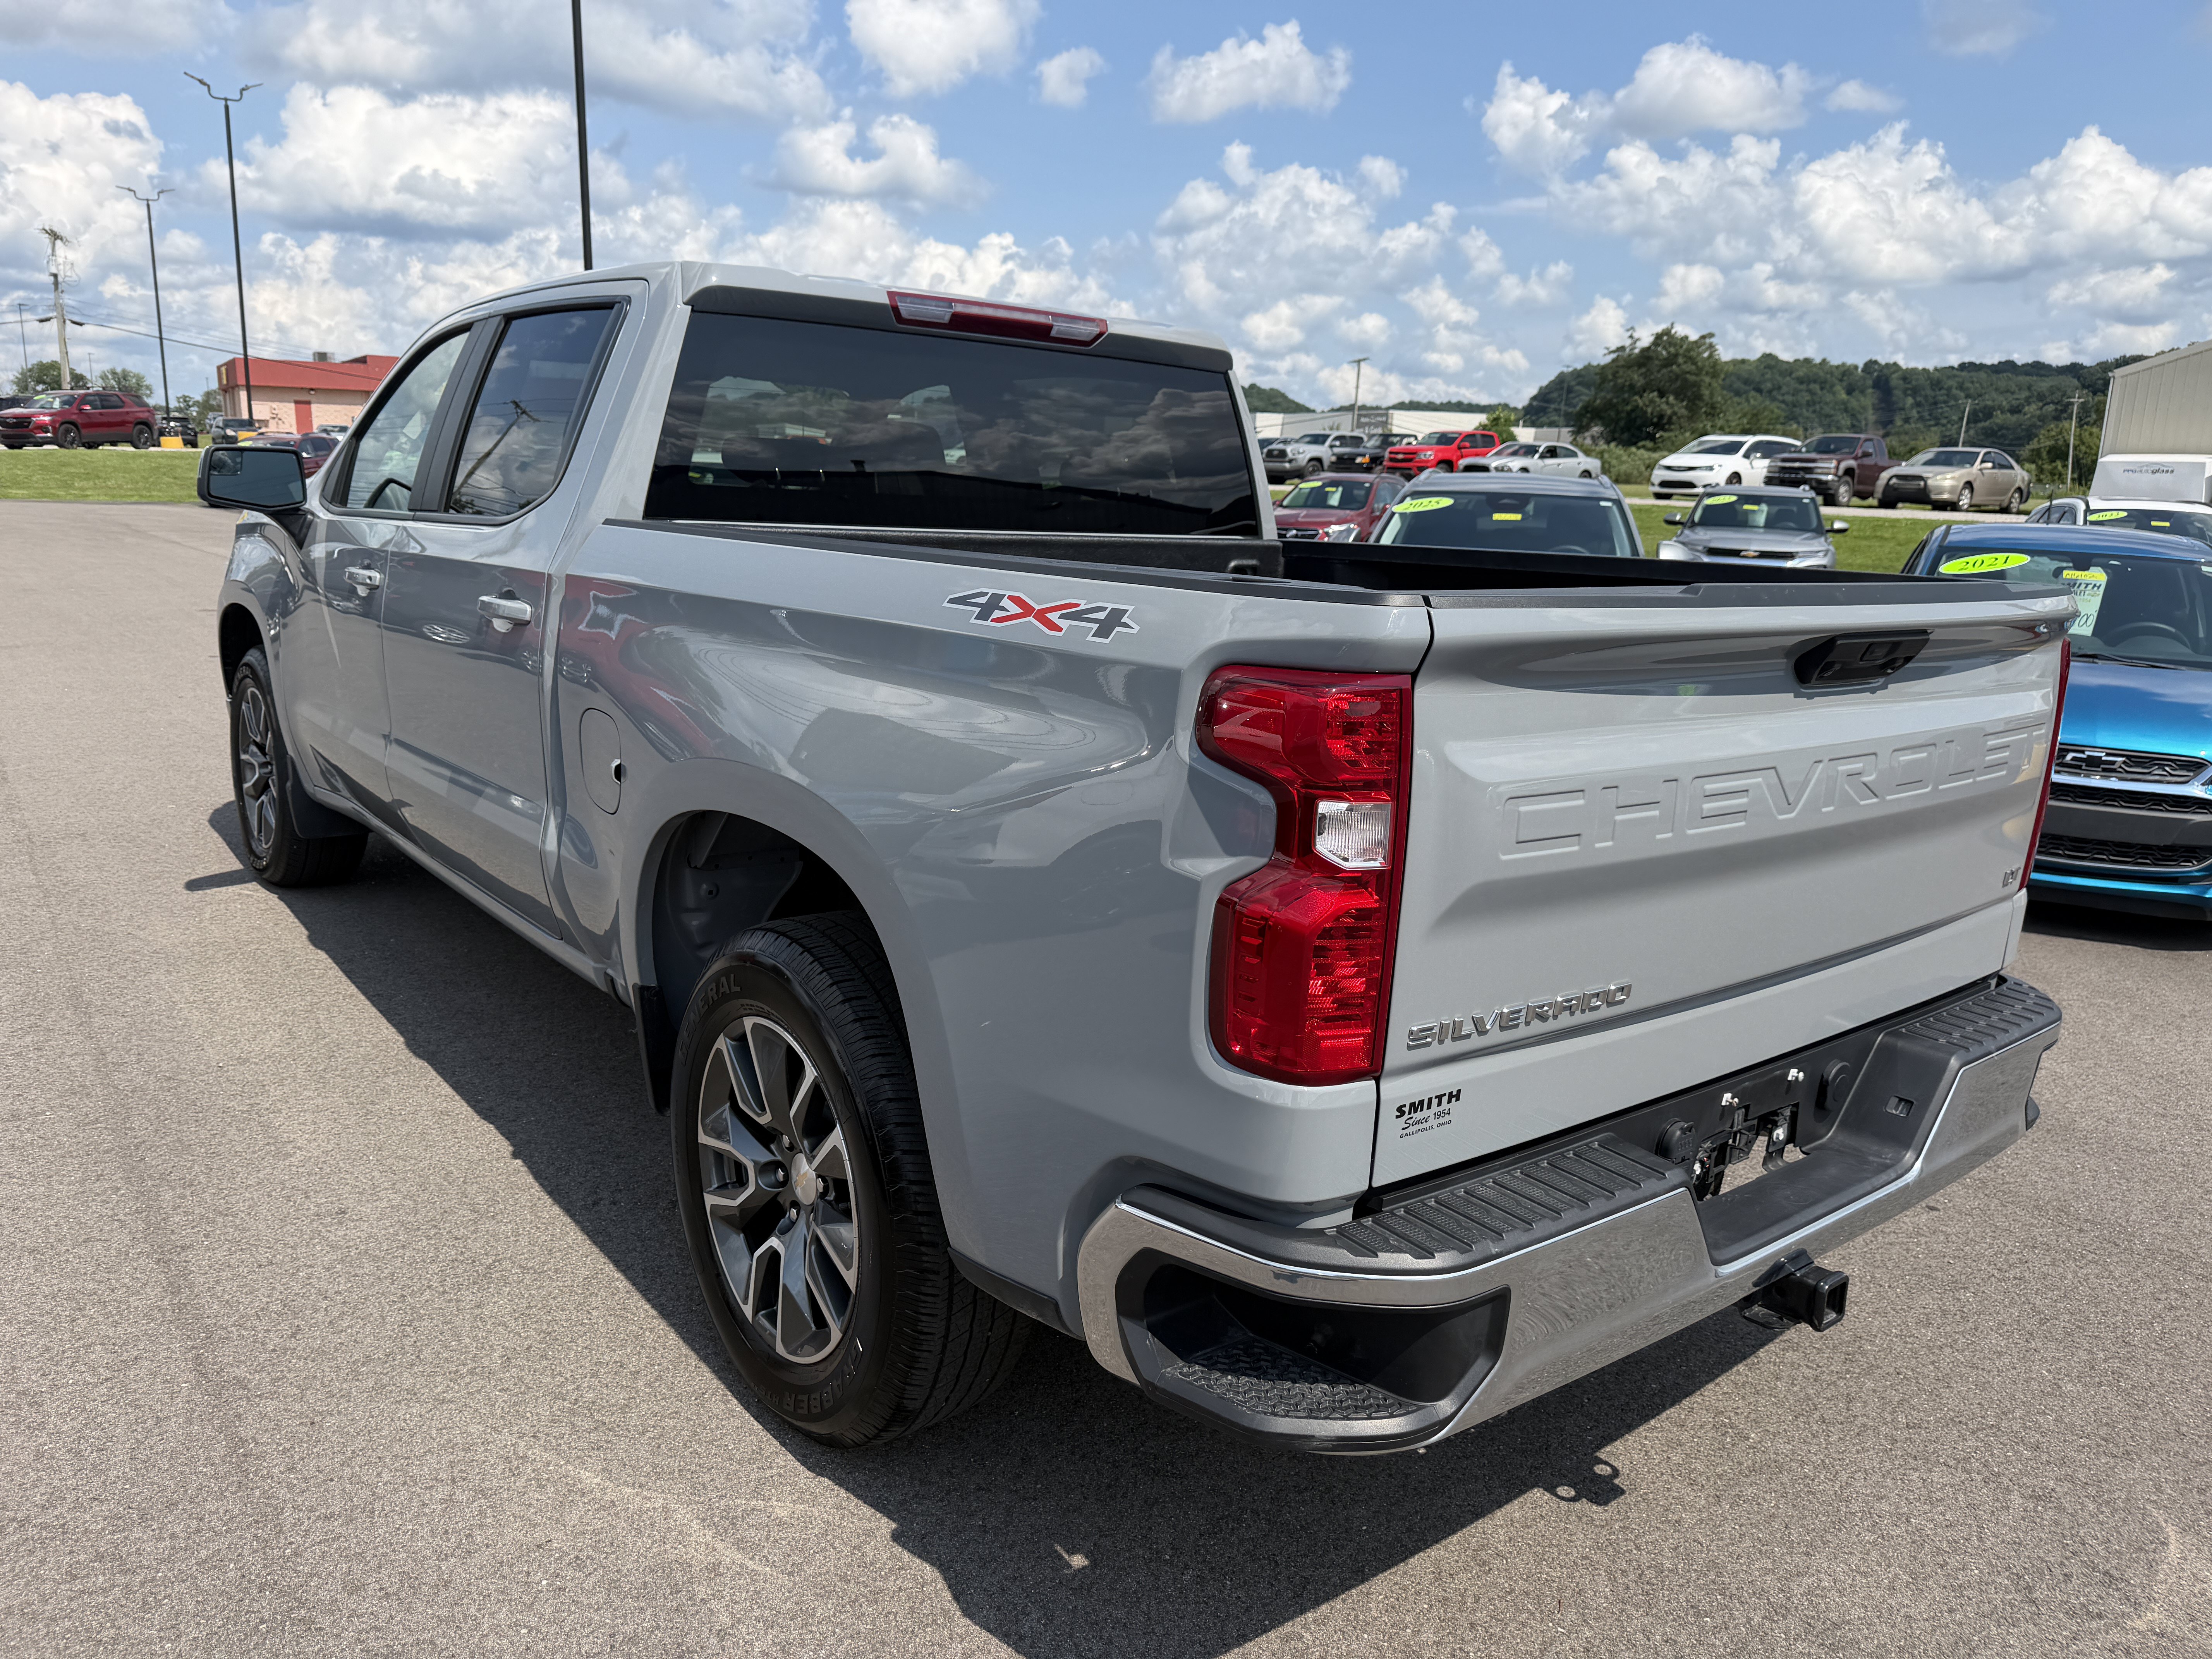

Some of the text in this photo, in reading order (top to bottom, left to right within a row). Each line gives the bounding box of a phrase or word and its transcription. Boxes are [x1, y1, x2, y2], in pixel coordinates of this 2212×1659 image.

[1958, 555, 2010, 572] 2021
[1499, 722, 2045, 860] CHEVROLET
[678, 974, 742, 1066] GENERAL
[1407, 981, 1632, 1048] SILVERADO
[1395, 1089, 1462, 1119] SMITH
[1400, 1120, 1452, 1139] GALLIPOLIS, OHIO
[1401, 1108, 1451, 1131] Since 1954
